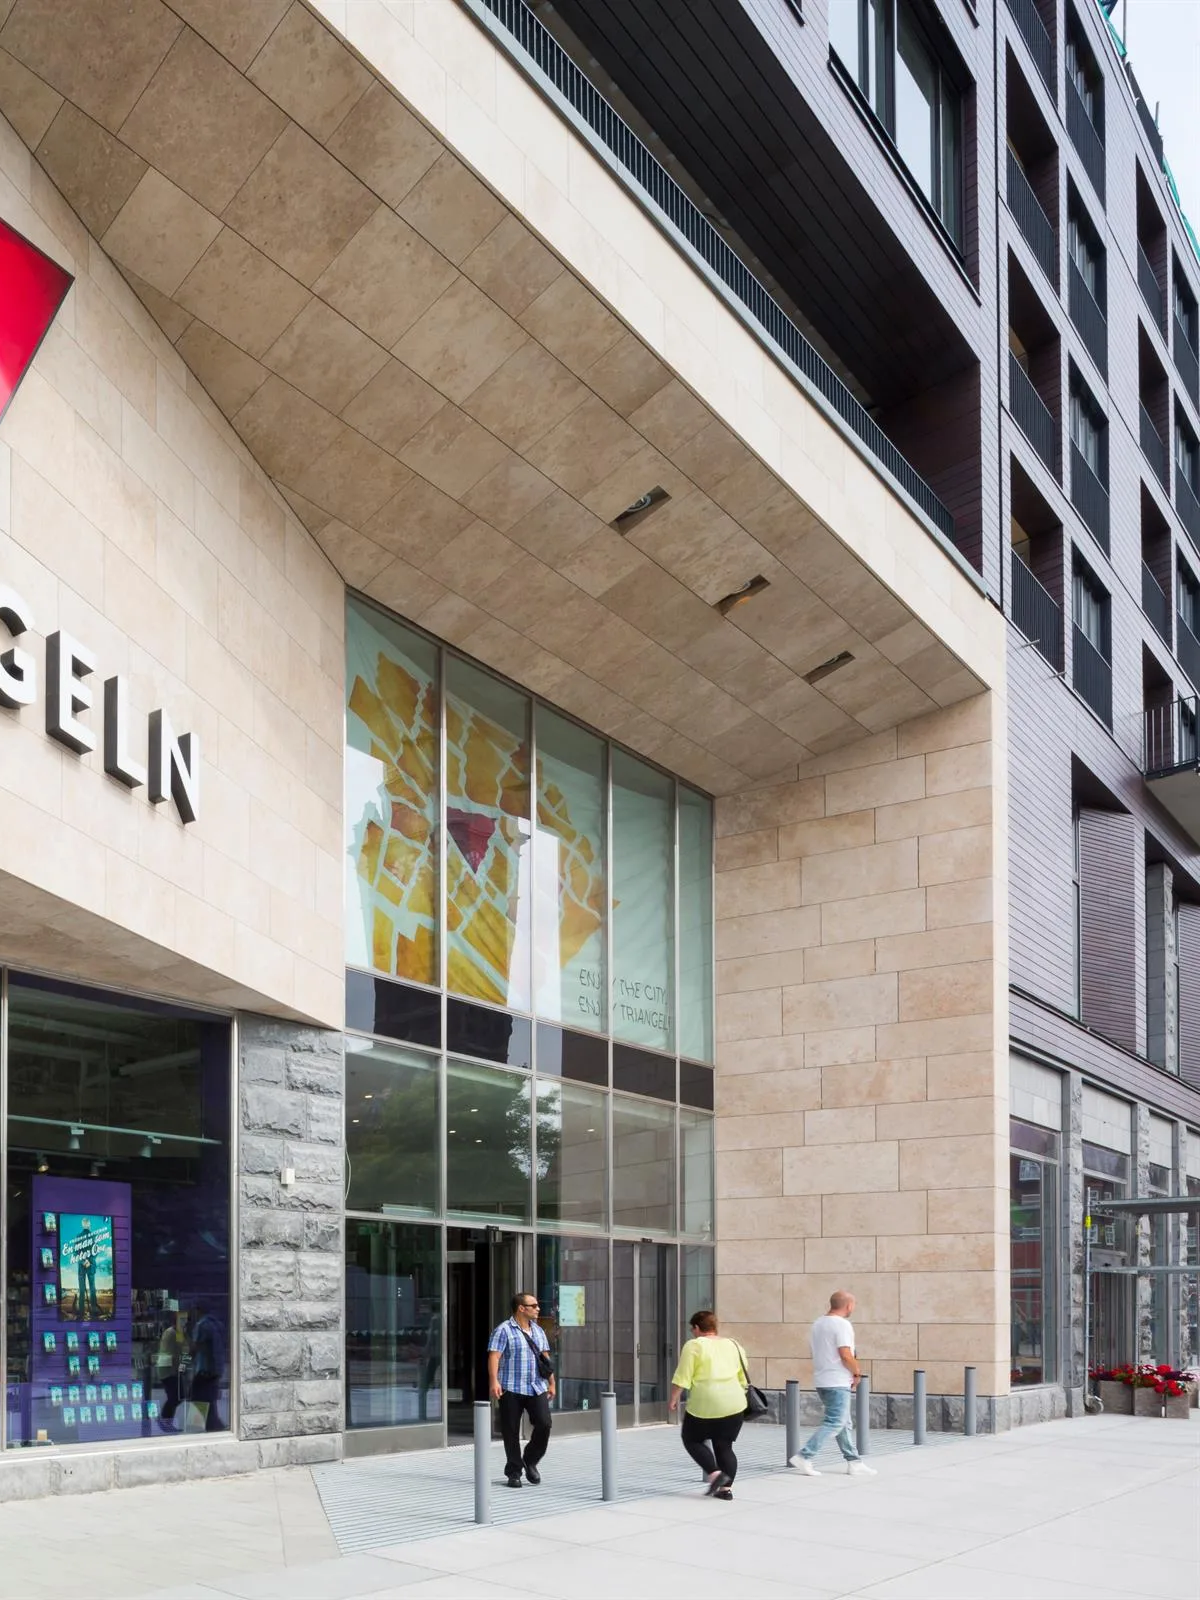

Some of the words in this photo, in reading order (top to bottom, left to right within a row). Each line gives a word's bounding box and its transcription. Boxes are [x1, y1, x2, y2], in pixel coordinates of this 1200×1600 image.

[580, 969, 616, 990] ENJ
[620, 979, 641, 999] THE
[578, 995, 617, 1017] ENJ
[62, 1243, 73, 1256] En
[74, 1238, 93, 1251] man
[70, 1250, 91, 1264] heter
